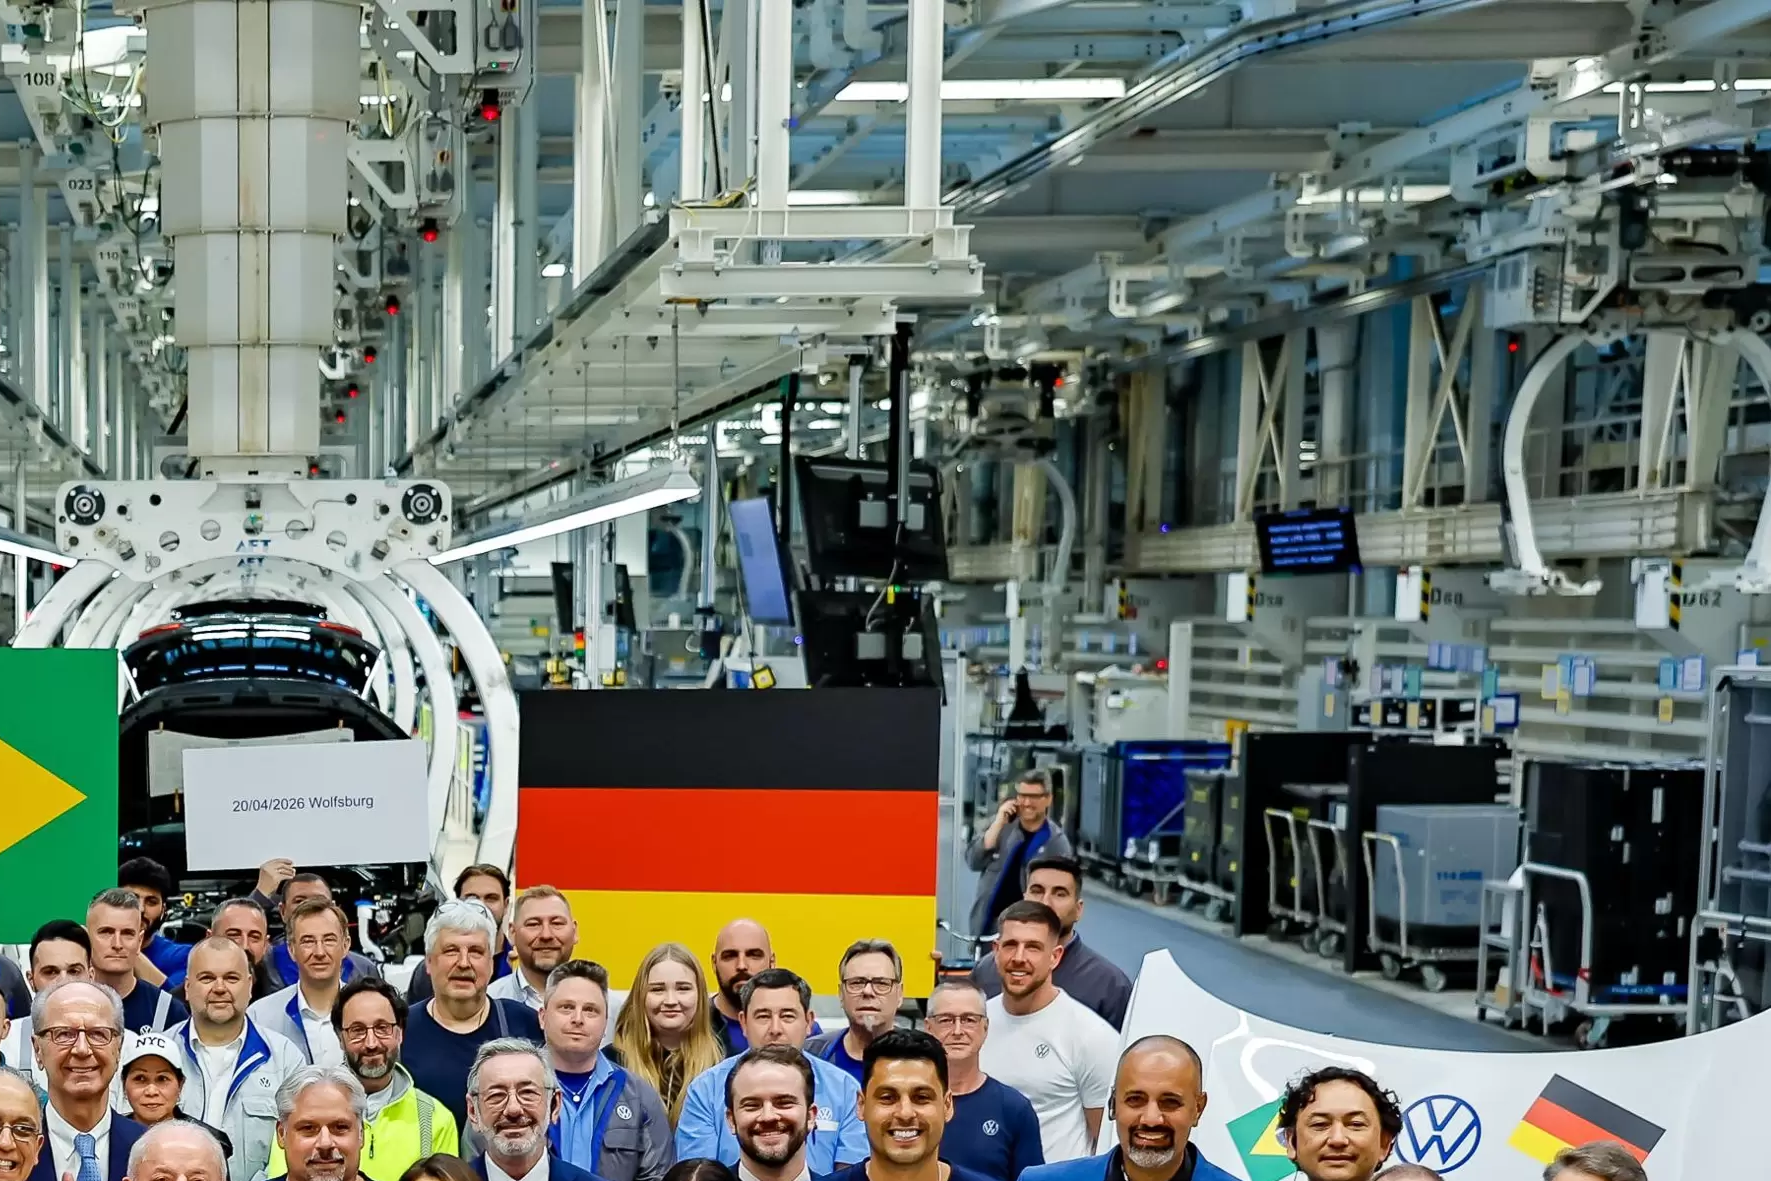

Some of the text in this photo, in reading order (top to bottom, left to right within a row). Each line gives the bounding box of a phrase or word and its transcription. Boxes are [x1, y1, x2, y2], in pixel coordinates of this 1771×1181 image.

[23, 72, 55, 87] 108
[68, 179, 93, 191] 023
[232, 796, 374, 812] 20/04/2026 Wolfsburg
[135, 1036, 166, 1049] NYC
[1034, 1043, 1049, 1059] VW
[258, 1076, 271, 1088] VW
[616, 1105, 633, 1120] VW
[983, 1119, 999, 1136] VW
[1395, 1094, 1482, 1174] VW
